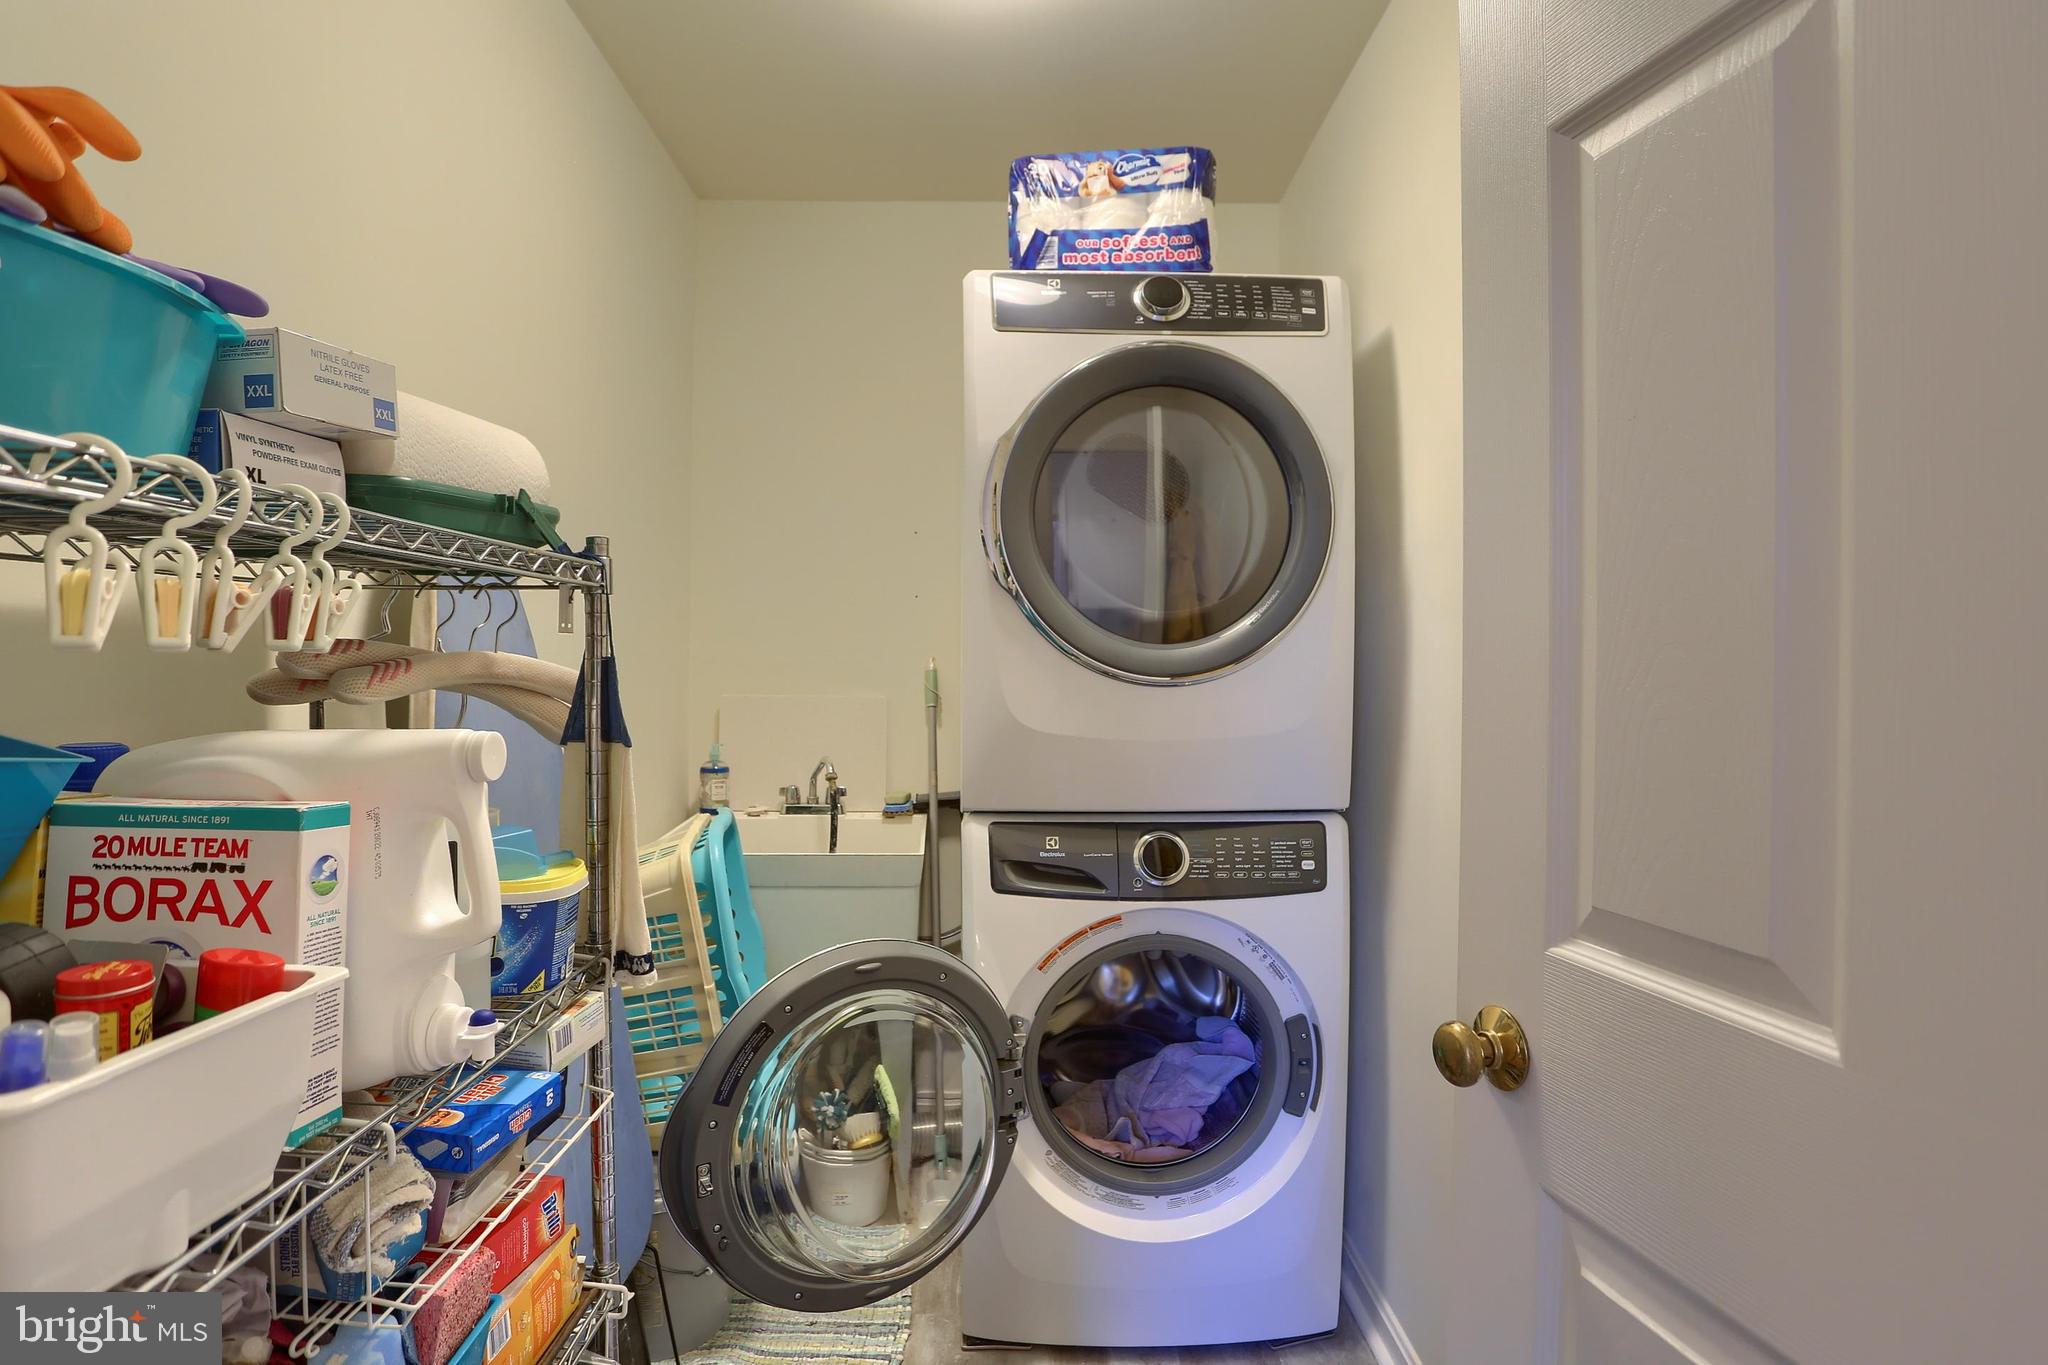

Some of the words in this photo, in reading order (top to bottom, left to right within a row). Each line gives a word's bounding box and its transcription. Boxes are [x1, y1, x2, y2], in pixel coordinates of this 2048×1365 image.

[1076, 239, 1099, 248] OUR
[1101, 233, 1168, 249] sofest
[1169, 236, 1193, 246] AND
[1063, 250, 1110, 264] most
[310, 348, 340, 365] NITRILE
[341, 358, 370, 374] GLOVES
[320, 363, 343, 377] LATEX
[344, 370, 364, 383] FREE
[247, 384, 273, 397] XXL
[314, 374, 343, 389] GENERAL
[344, 383, 370, 396] PURPOSE
[375, 407, 395, 422] XXL
[235, 432, 257, 445] VINYL
[258, 437, 295, 454] SYNTHETIC
[252, 449, 299, 467] POWDER-FREE
[300, 460, 318, 471] EXAM
[319, 464, 342, 477] GLOVES
[245, 465, 267, 485] XL
[118, 814, 135, 822] ALL
[137, 814, 180, 823] NATURAL
[182, 815, 209, 824] SINCE
[211, 816, 230, 824] 1891
[92, 835, 125, 859] 20
[127, 836, 188, 857] MULE
[191, 837, 250, 858] TEAM
[65, 875, 274, 935] BORAX
[317, 908, 341, 918] NATURAL
[310, 918, 325, 928] SINCE
[452, 1074, 510, 1105] Clean
[291, 1221, 300, 1260] RESISTAN
[280, 1236, 291, 1272] STRONG
[292, 1261, 300, 1278] TEAR
